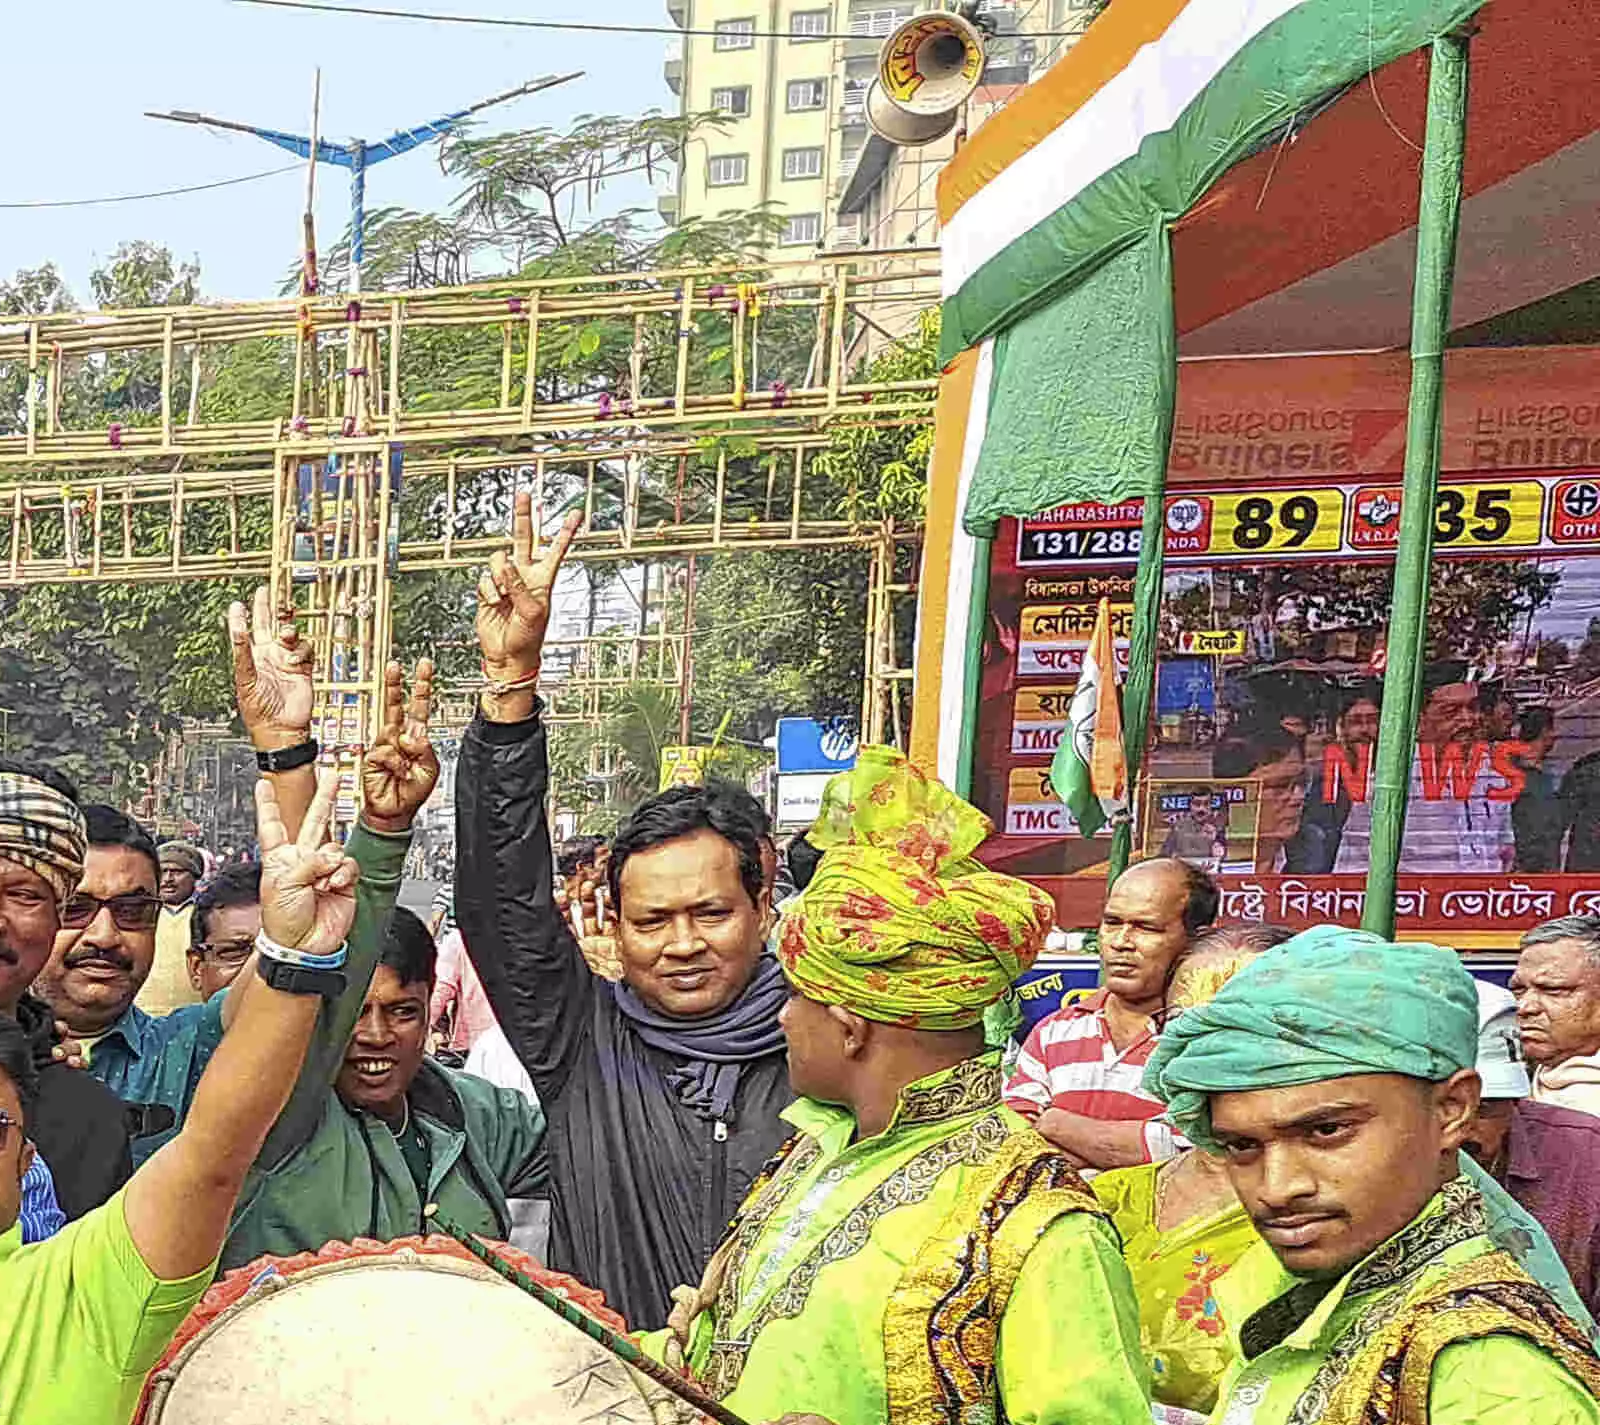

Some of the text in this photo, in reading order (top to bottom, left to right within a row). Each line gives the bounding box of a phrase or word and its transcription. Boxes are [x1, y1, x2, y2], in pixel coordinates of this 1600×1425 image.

[1232, 496, 1319, 550] 89
[1433, 488, 1512, 543] 35
[1031, 529, 1143, 557] 131/288
[1166, 536, 1200, 550] NDA
[1320, 742, 1531, 804] NWS
[1012, 810, 1061, 830] TMC
[1441, 883, 1557, 918] ভোটের
